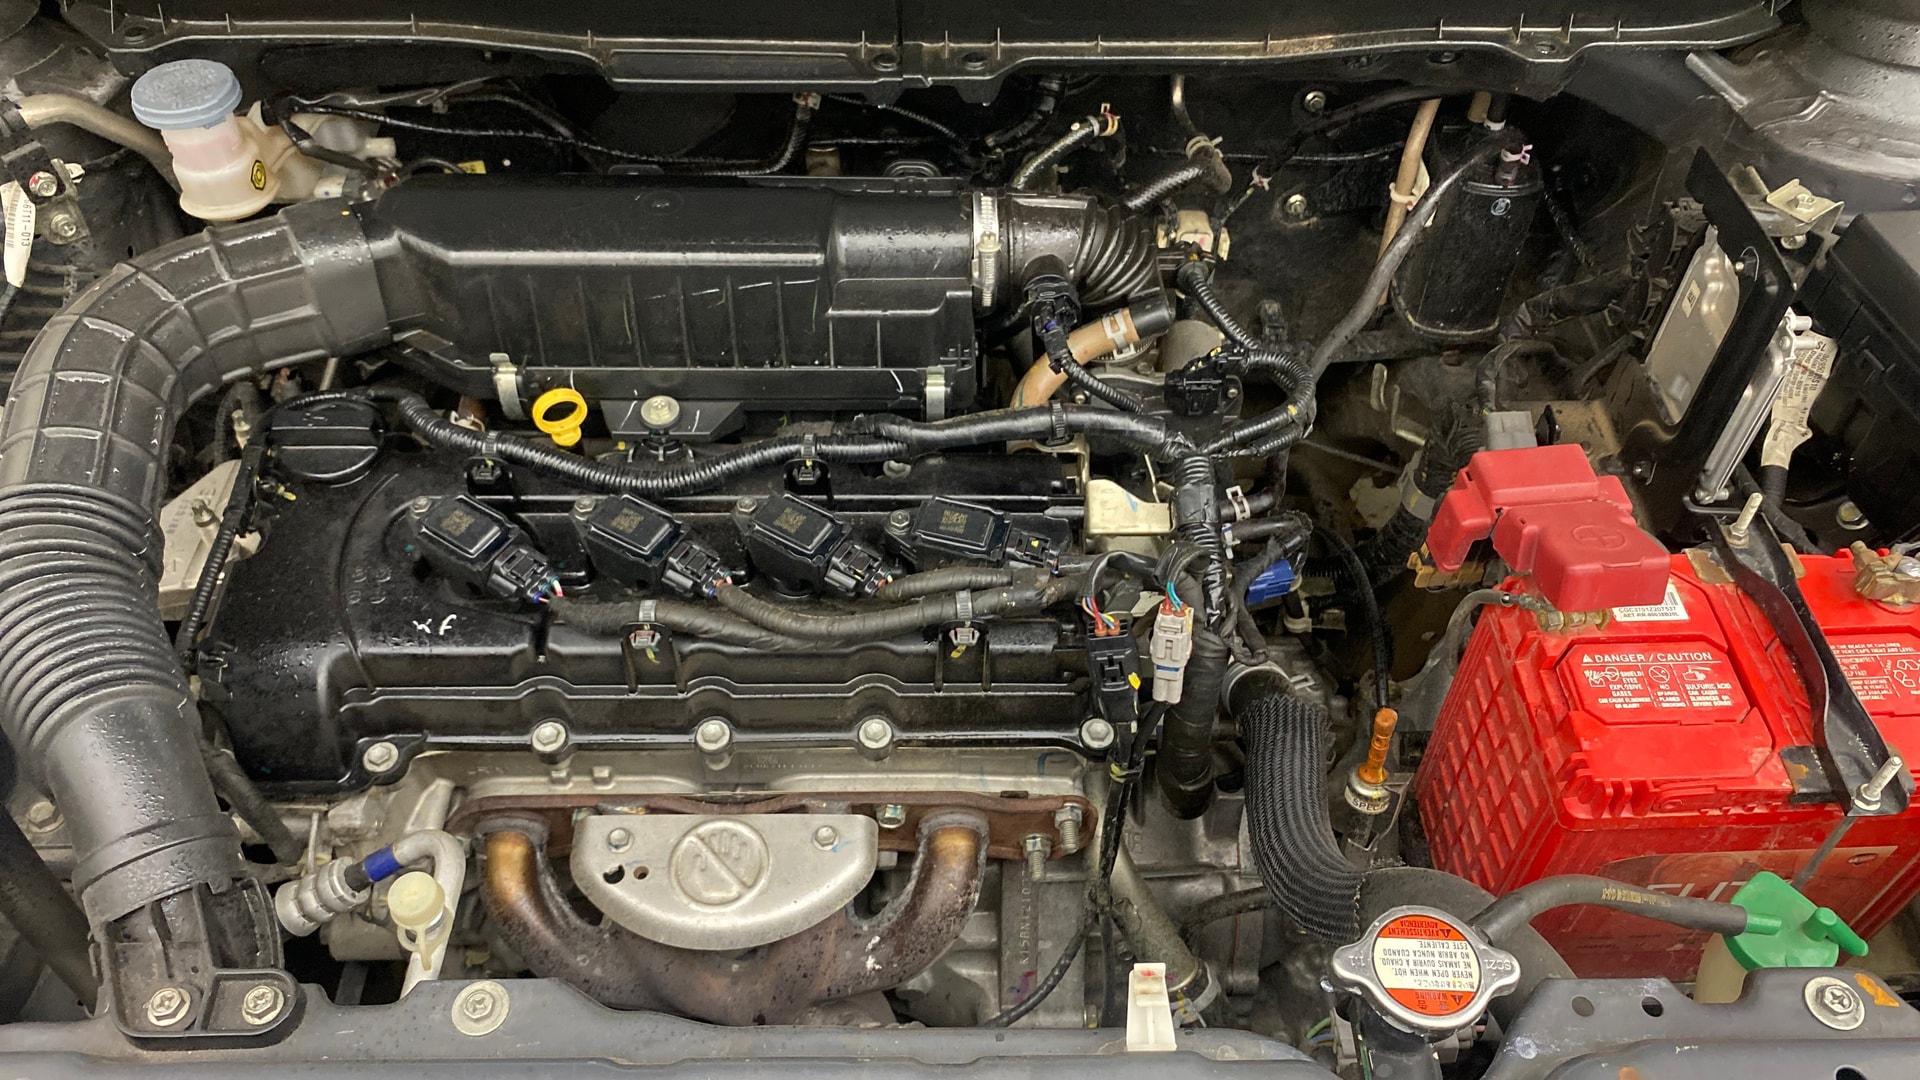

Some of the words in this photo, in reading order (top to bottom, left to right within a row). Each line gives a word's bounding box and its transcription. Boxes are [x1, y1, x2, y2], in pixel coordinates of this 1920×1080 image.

[1595, 654, 1646, 662] DANGER
[1657, 652, 1712, 662] CAUTION
[1400, 920, 1438, 928] ADVERTENCIA
[1388, 927, 1440, 937] AVERTISSEMENT
[1452, 942, 1468, 950] ESTE
[1383, 949, 1410, 957] CUANDO
[1412, 949, 1435, 958] NUNCA
[1438, 950, 1457, 959] ABRIR
[1412, 959, 1436, 967] OUVRIR
[1438, 960, 1460, 968] JAMAIS
[1462, 961, 1472, 969] NE
[1409, 968, 1429, 977] WHEN
[1431, 969, 1449, 978] OPEN
[1452, 970, 1473, 978] NEVER
[1415, 992, 1448, 1000] WARNING
